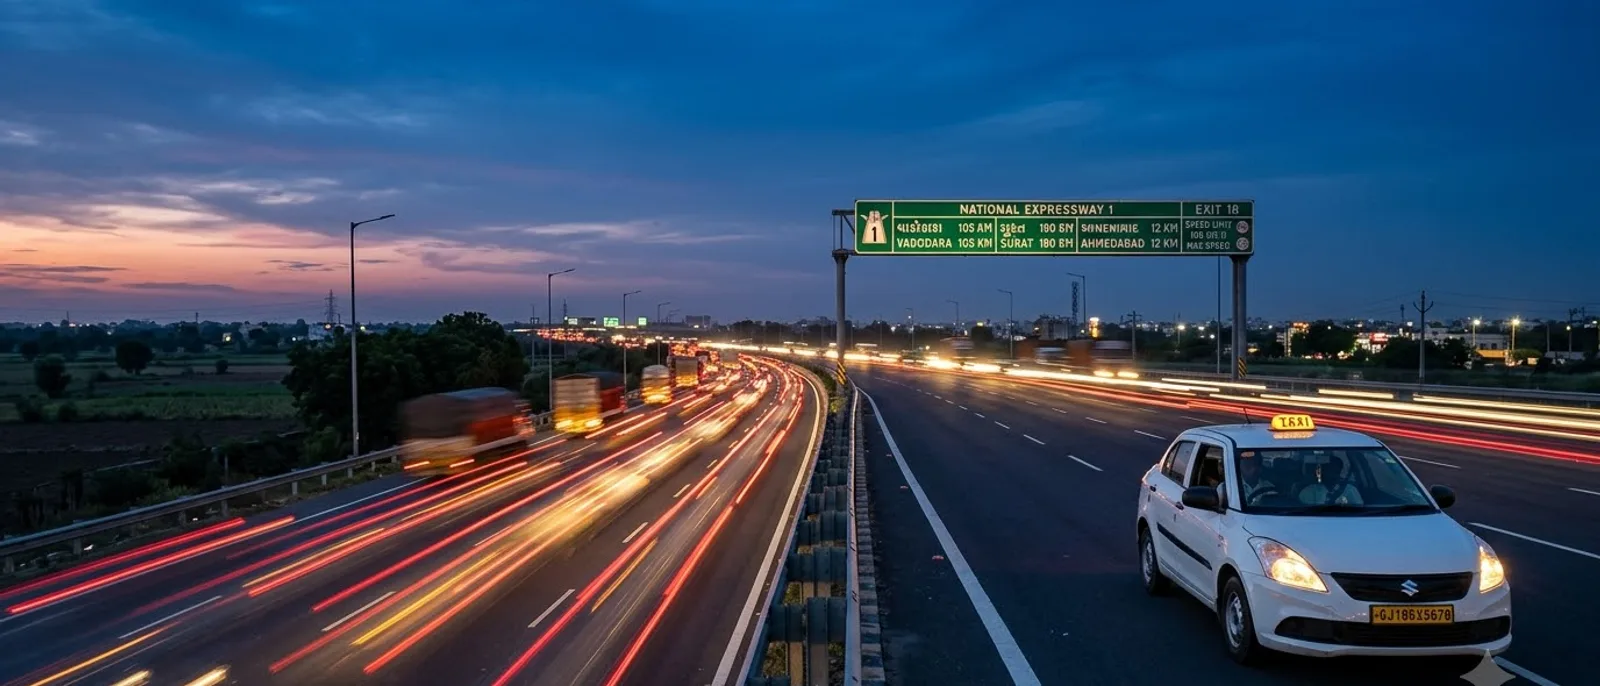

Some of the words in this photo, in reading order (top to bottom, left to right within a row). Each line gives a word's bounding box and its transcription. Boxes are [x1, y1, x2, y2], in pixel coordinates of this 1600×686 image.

[960, 204, 1020, 215] NATIONAL
[1024, 204, 1104, 215] EXPRESSWAY
[1108, 204, 1113, 215] 1
[1195, 204, 1222, 215] EXIT
[1226, 204, 1239, 215] 18
[1151, 223, 1161, 233] 12
[1163, 223, 1178, 233] KM
[871, 226, 877, 243] 1
[897, 238, 953, 248] VADODARA
[1000, 238, 1034, 248] SURAT
[1080, 238, 1145, 248] AHMEDABAD
[1151, 238, 1161, 248] 12
[1163, 238, 1178, 248] KM
